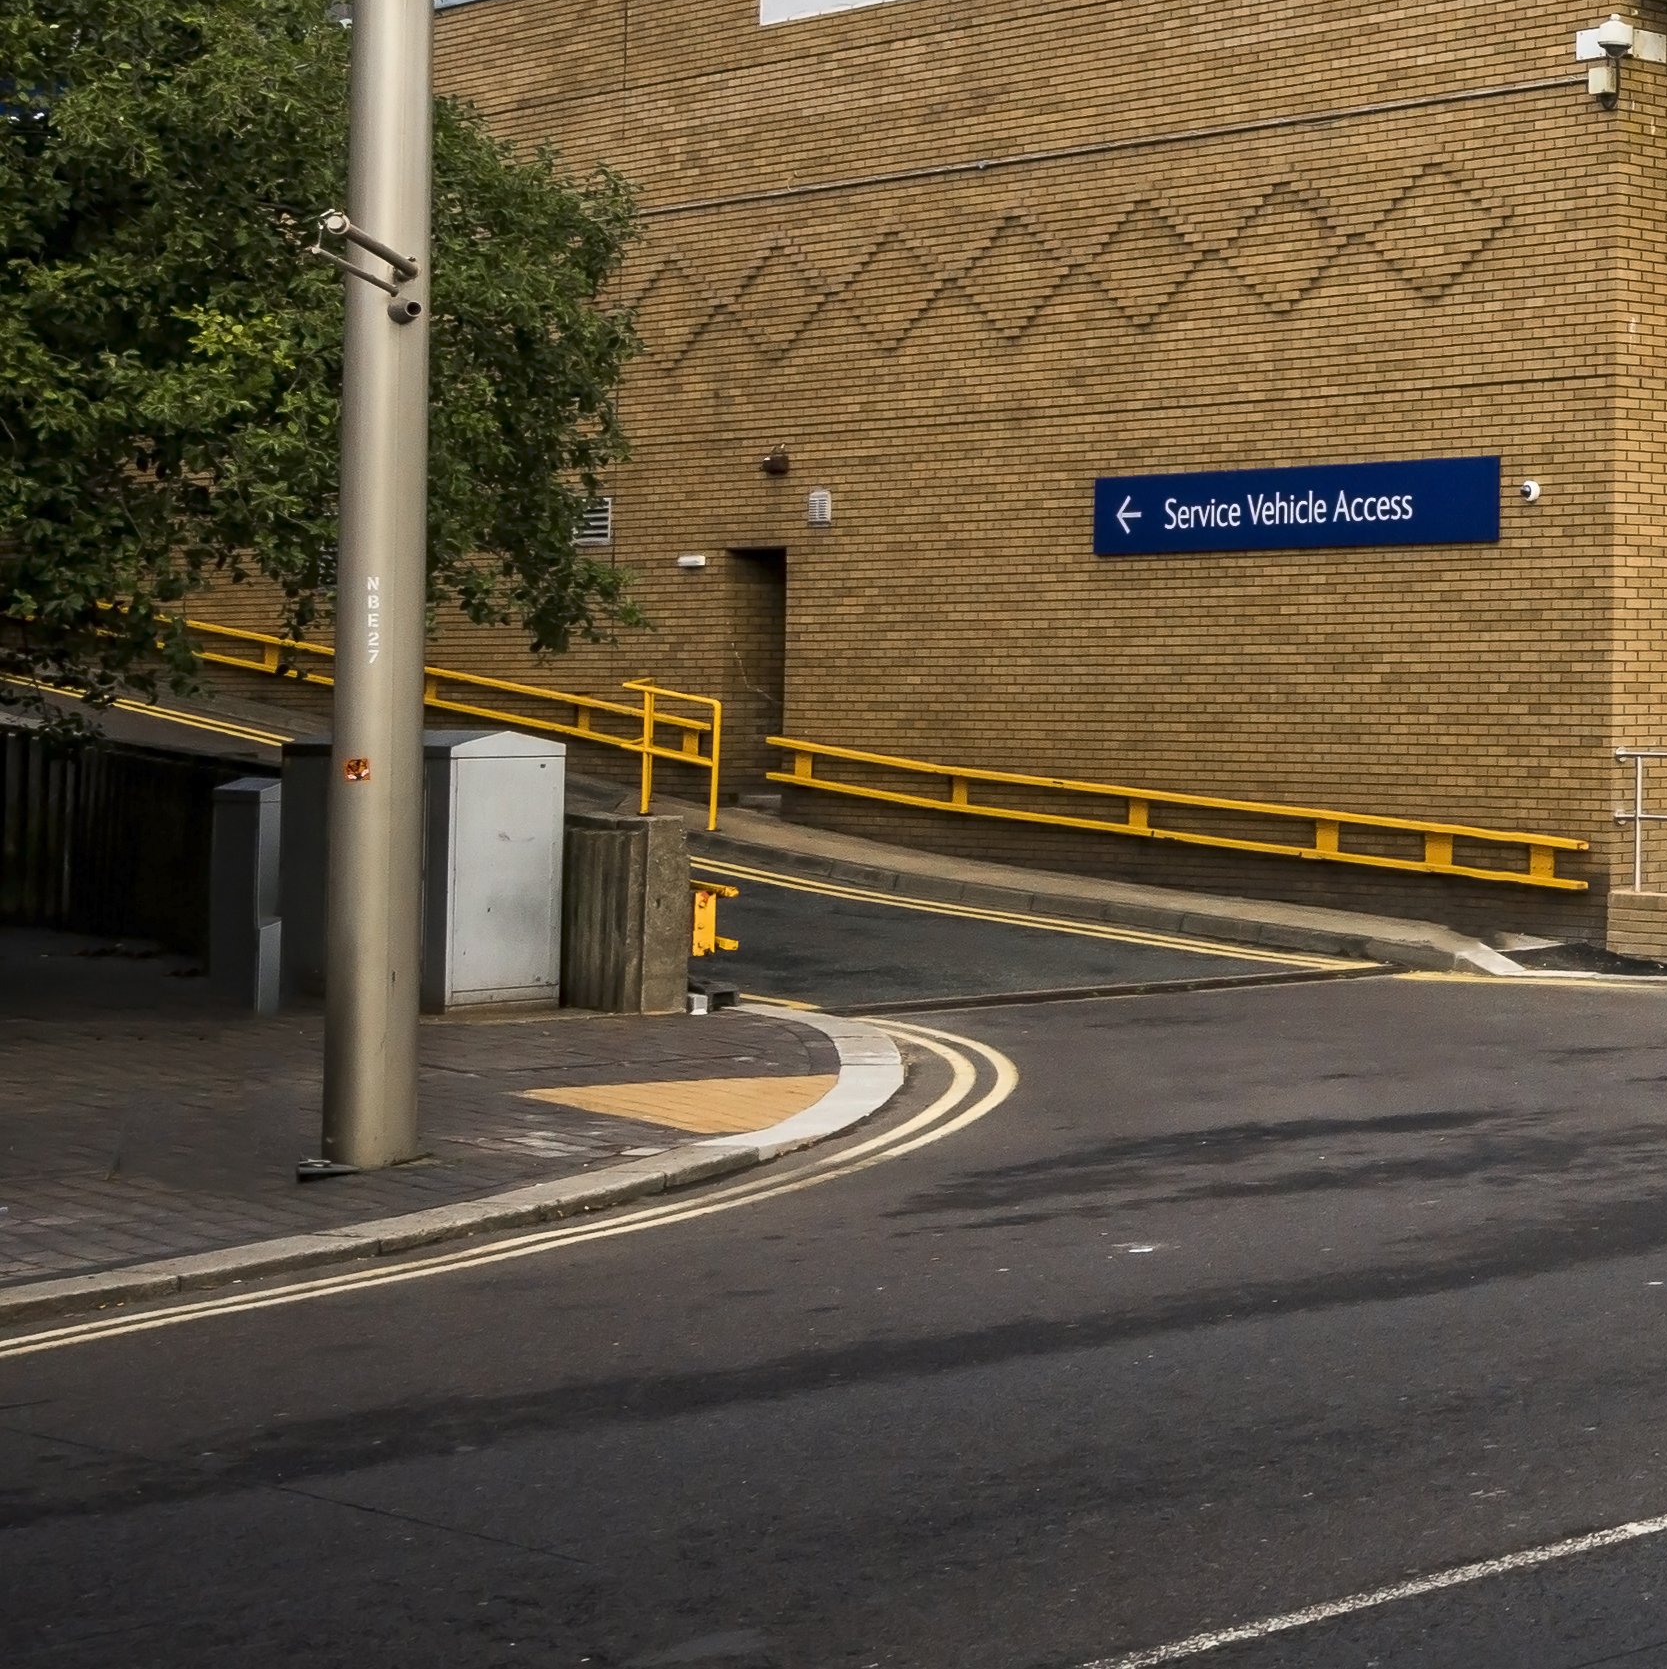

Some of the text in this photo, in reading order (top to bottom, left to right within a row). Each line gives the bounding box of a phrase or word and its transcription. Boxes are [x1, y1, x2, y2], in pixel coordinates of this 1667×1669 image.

[1164, 490, 1413, 530] Service Vehicle Access
